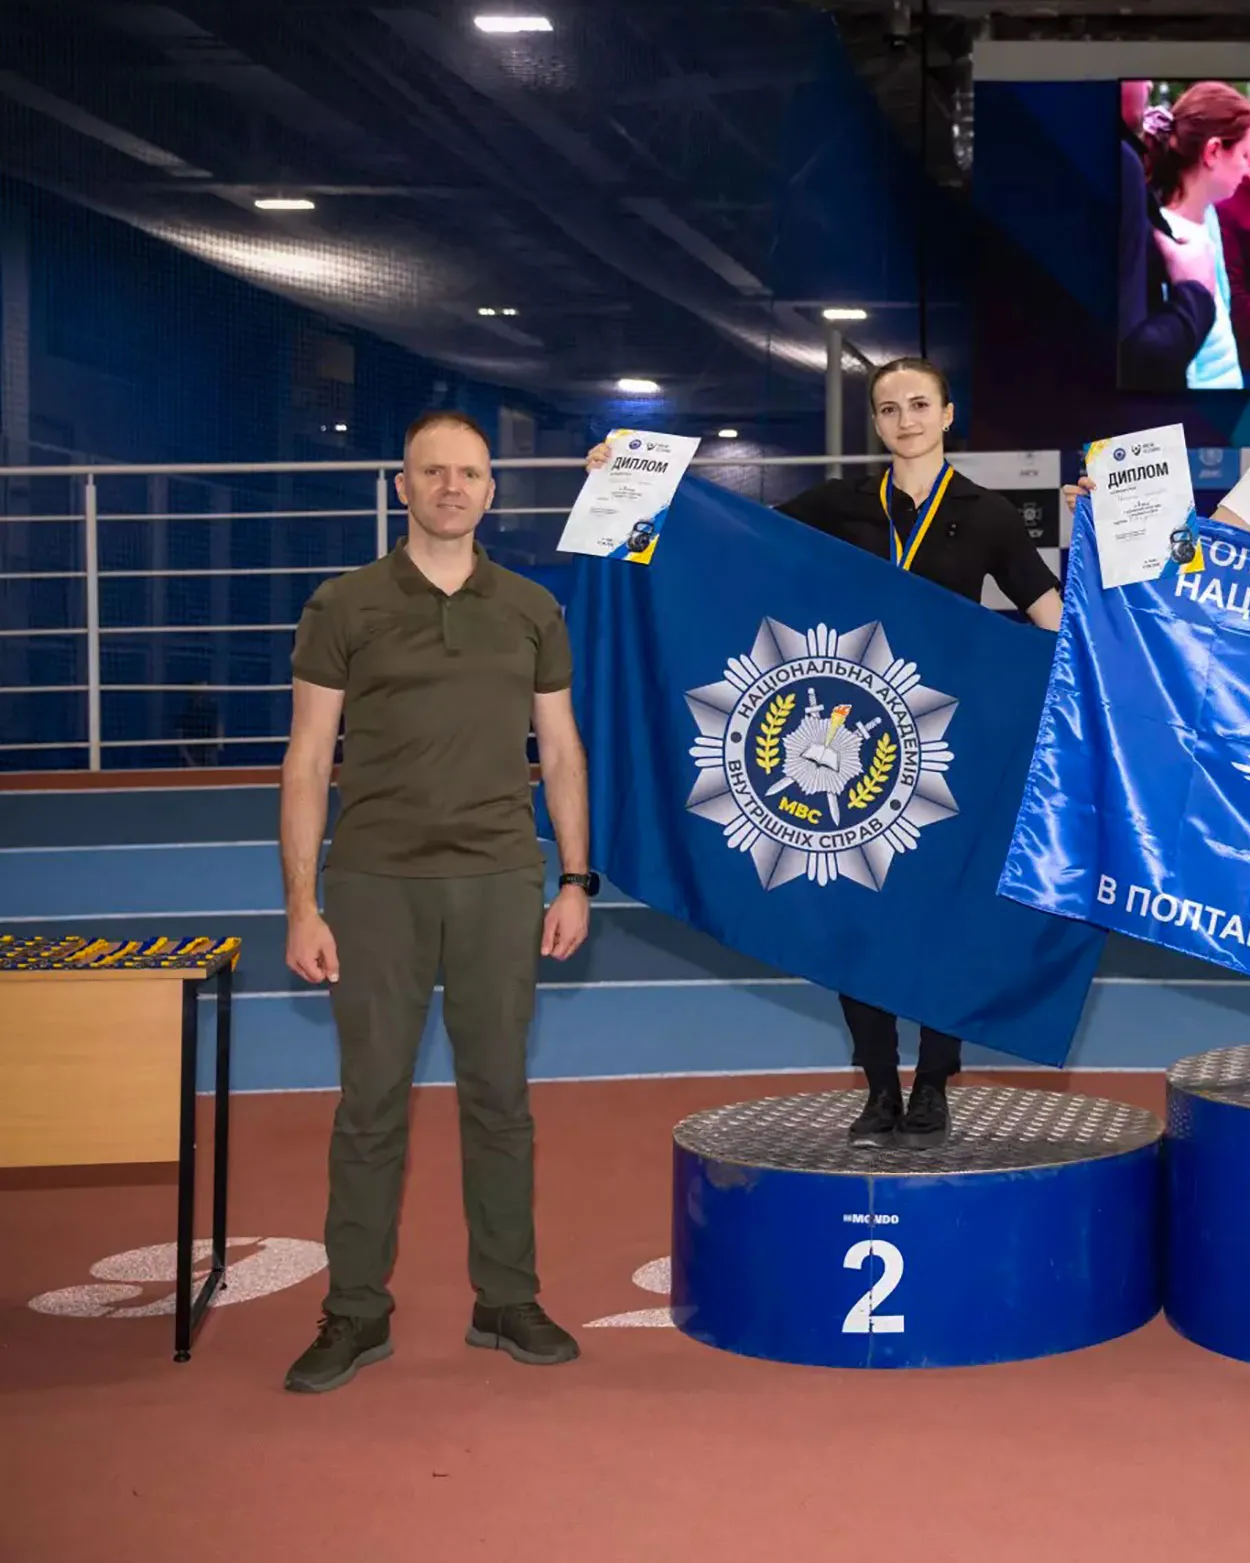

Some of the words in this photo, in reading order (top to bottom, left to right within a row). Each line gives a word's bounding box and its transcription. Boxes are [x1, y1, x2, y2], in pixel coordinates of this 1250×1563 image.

[611, 457, 669, 473] ДИПЛОМ
[1108, 462, 1169, 489] ДИПЛОМ
[738, 660, 874, 719] НАЦІОНАЛЬНА
[877, 686, 918, 787] АКАДЕМІЯ
[728, 759, 812, 848] ВНУТРІШНІХ
[819, 817, 883, 849] СПРАВ
[778, 796, 823, 825] МВС
[1097, 874, 1117, 905] В
[842, 1239, 904, 1333] 2
